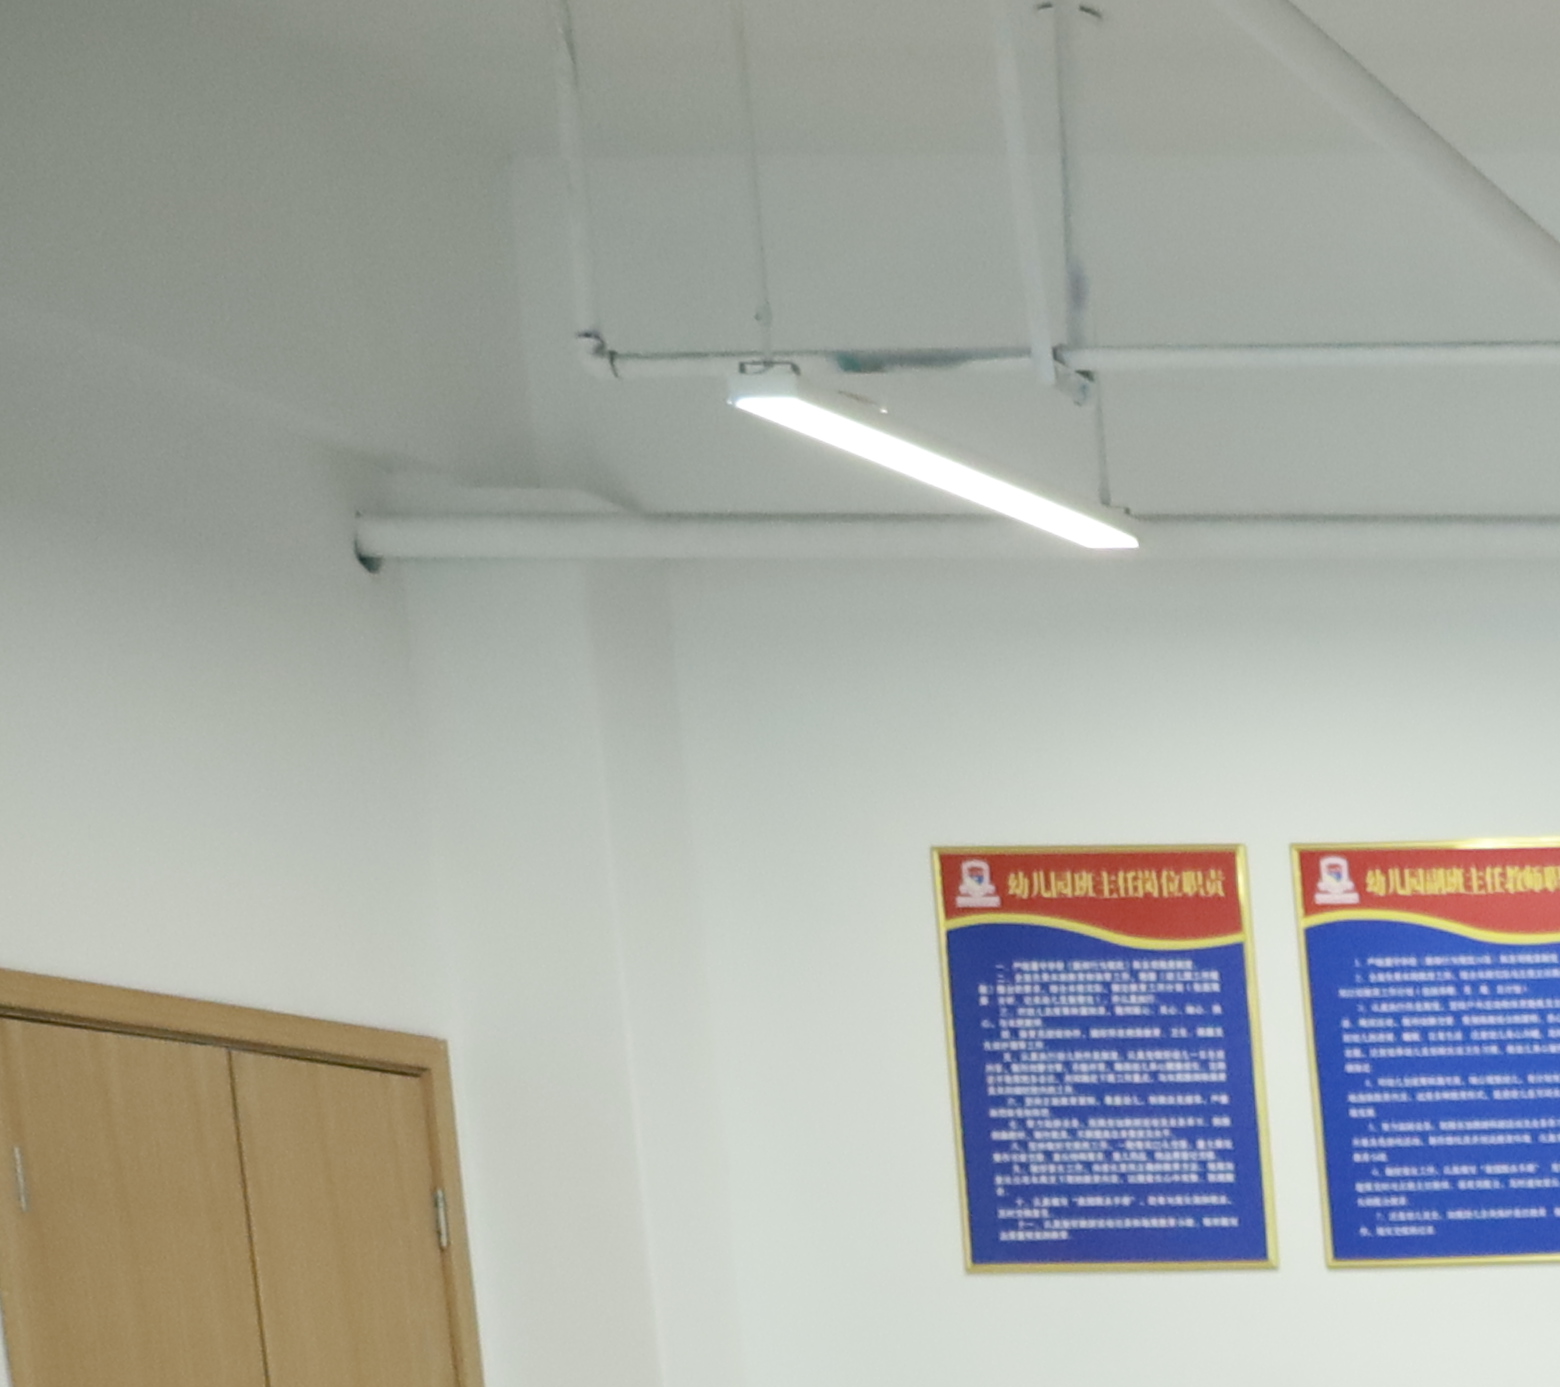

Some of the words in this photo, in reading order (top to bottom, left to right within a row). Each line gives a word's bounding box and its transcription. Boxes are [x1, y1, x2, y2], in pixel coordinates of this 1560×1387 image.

[1007, 868, 1226, 900] 幼儿园班主任岗位职责
